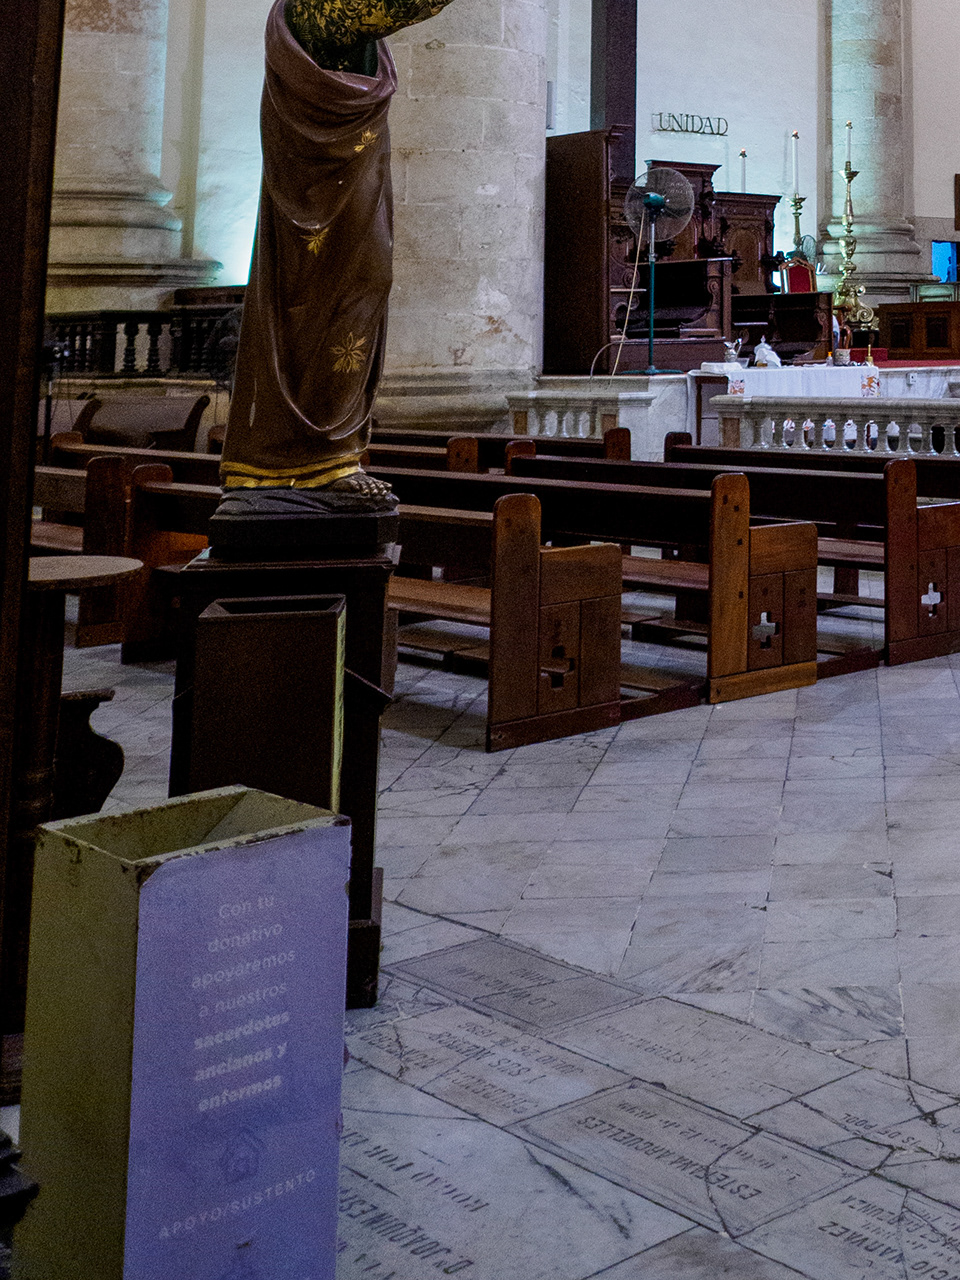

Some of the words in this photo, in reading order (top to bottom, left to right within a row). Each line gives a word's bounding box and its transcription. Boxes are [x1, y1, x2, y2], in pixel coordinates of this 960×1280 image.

[653, 112, 729, 137] UNIDAD
[207, 923, 283, 952] donativo
[191, 950, 296, 989] apoyaremos
[214, 982, 287, 1013] nuestros
[277, 1040, 288, 1059] y
